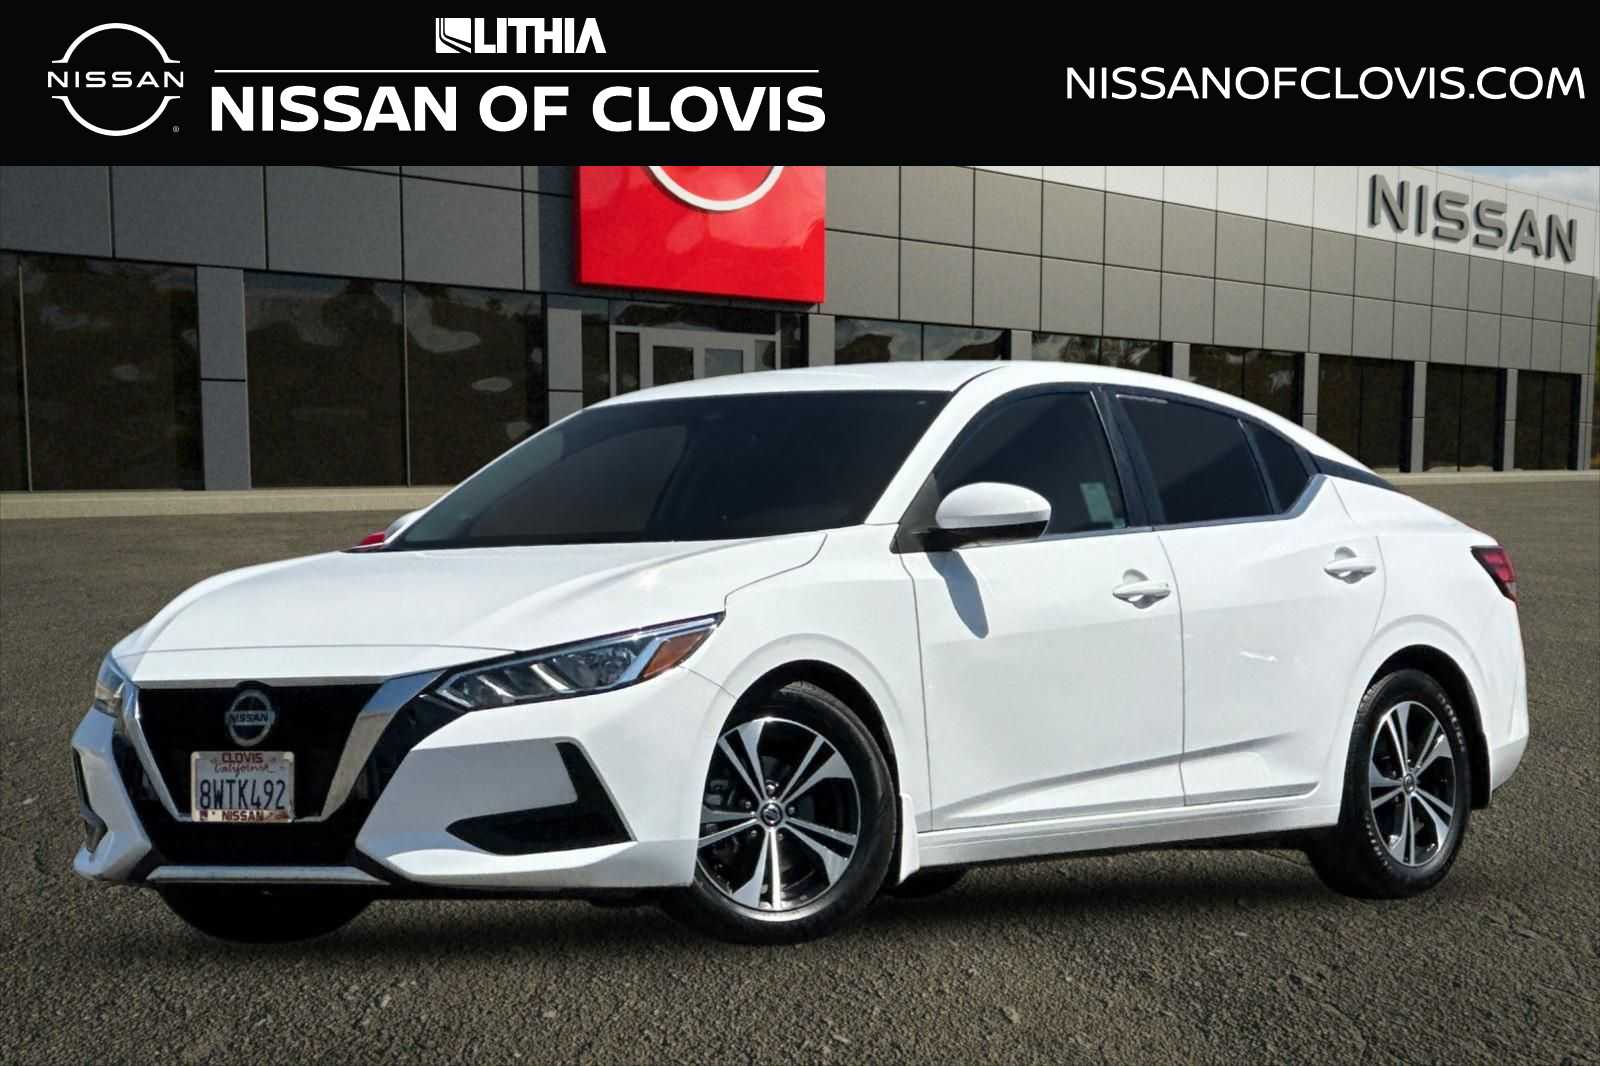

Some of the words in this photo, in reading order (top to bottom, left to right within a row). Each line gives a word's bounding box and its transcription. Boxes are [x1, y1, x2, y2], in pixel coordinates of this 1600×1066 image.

[1368, 174, 1578, 263] NISSAN
[227, 711, 270, 723] NISSAN
[222, 752, 264, 763] CLOVIS
[199, 779, 286, 810] 8WTK492
[222, 811, 265, 821] NISSAN
